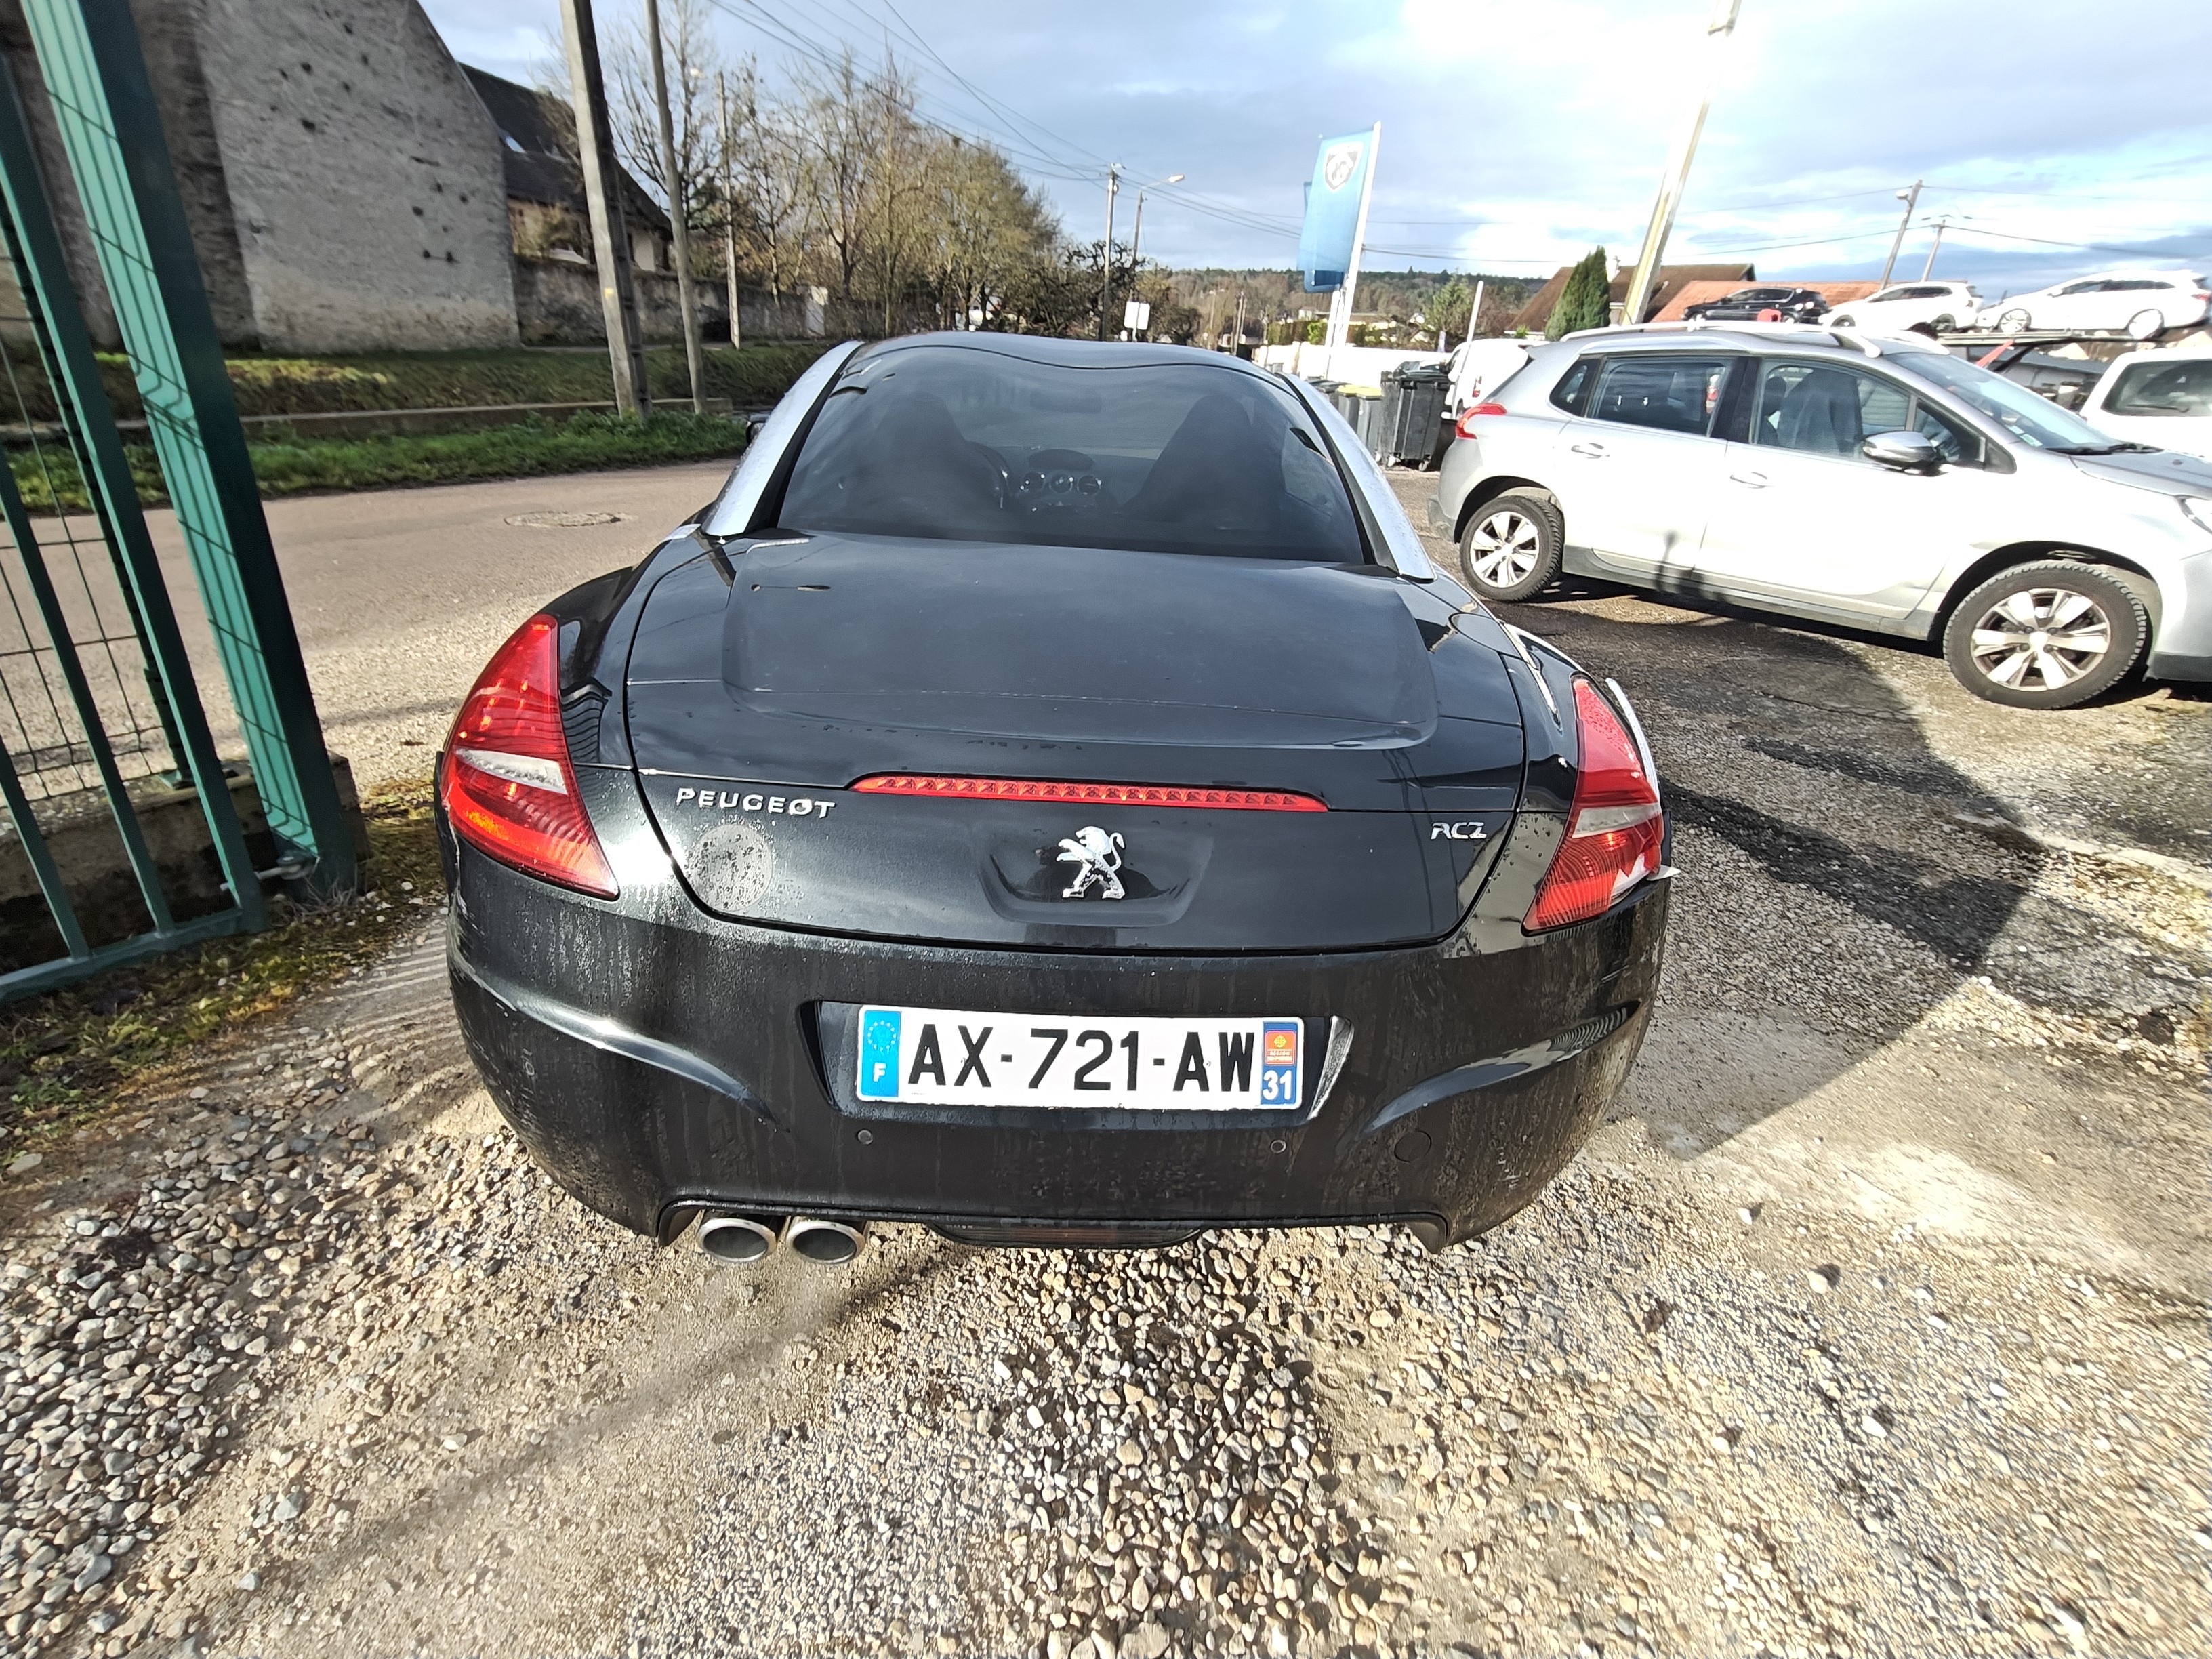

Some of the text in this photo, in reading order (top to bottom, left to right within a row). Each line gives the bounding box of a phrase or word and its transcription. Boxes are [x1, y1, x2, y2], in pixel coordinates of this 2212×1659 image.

[676, 787, 836, 819] PEUGEOT
[1431, 821, 1488, 840] RCZ
[873, 1062, 887, 1082] F
[908, 1024, 1254, 1092] AX-721-AW
[1263, 1070, 1292, 1100] 31
